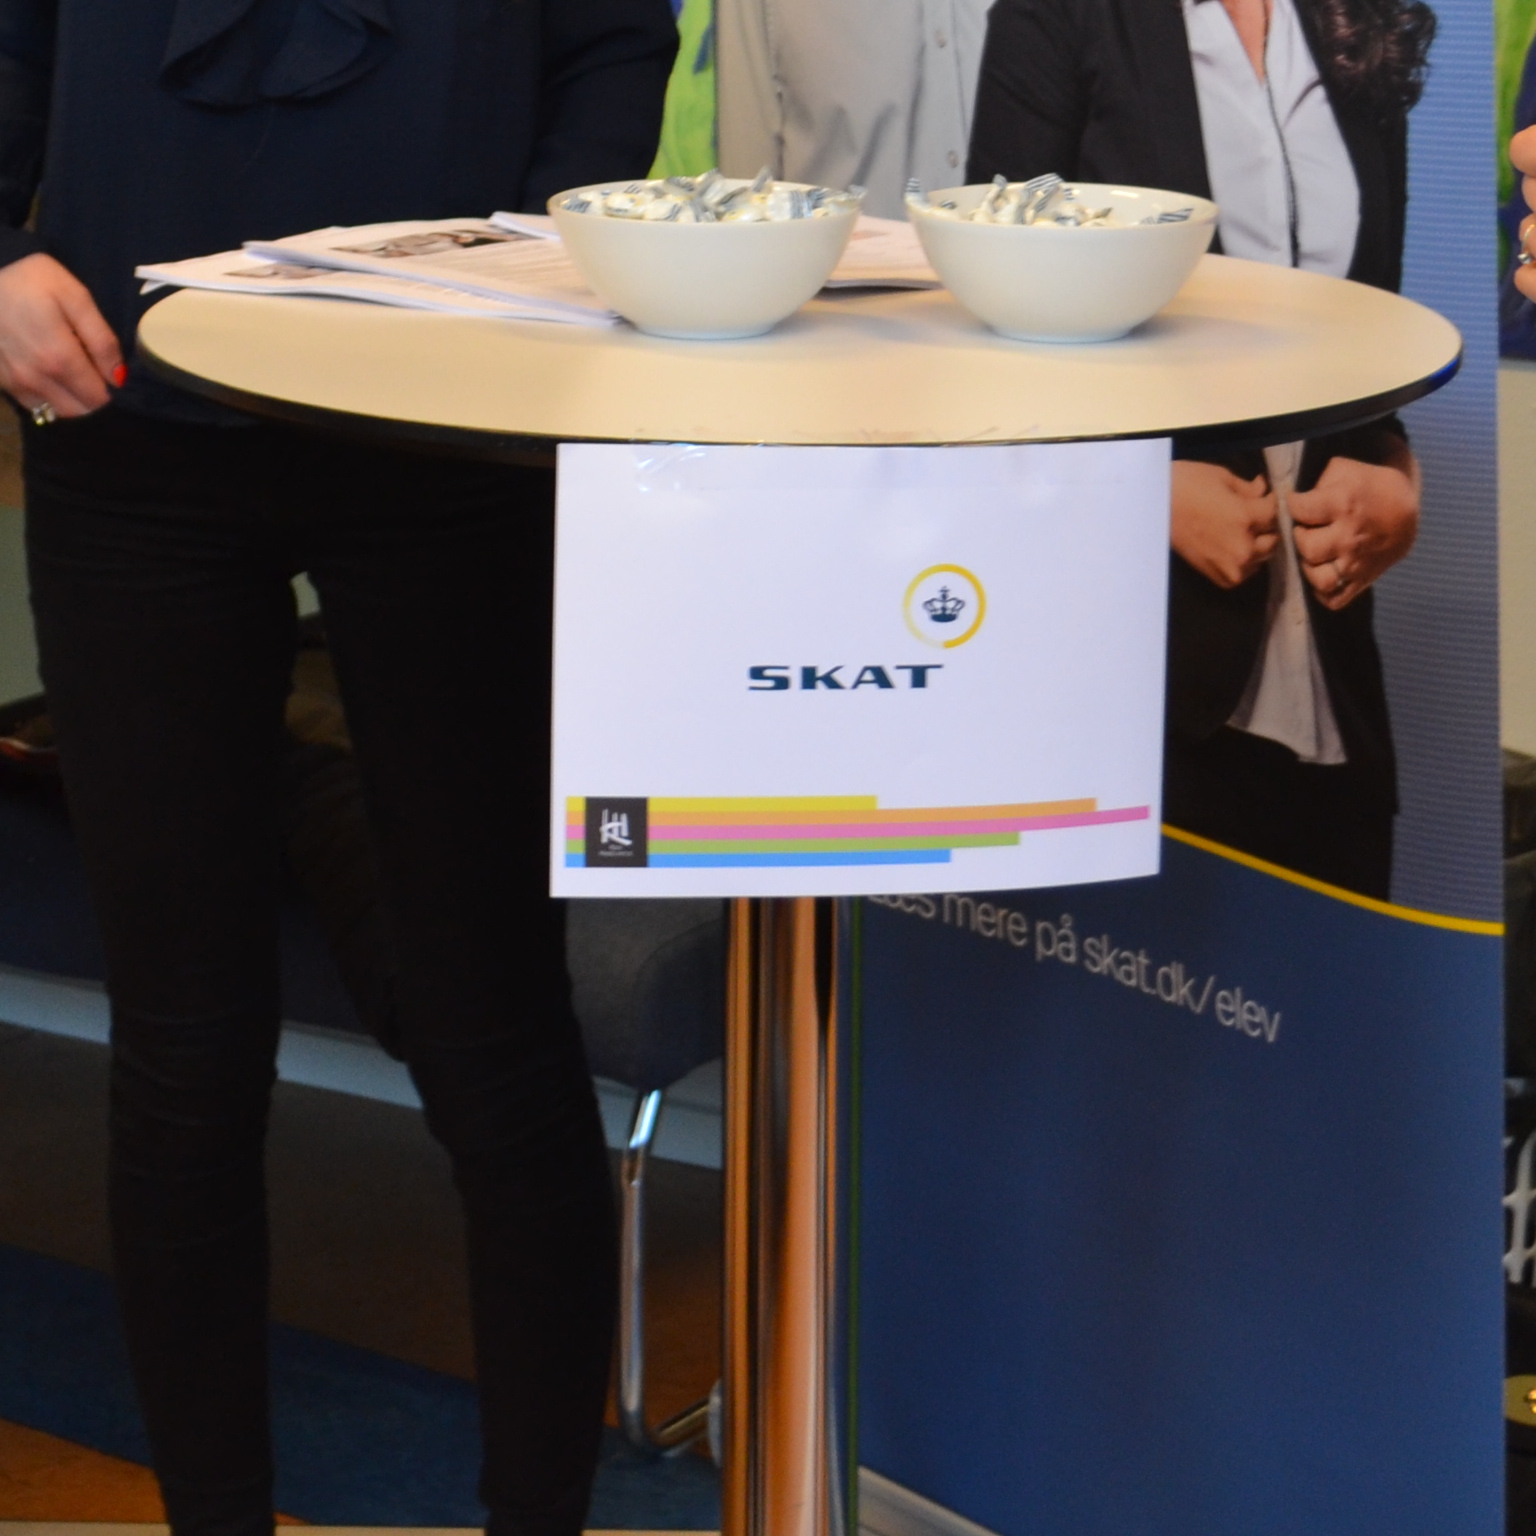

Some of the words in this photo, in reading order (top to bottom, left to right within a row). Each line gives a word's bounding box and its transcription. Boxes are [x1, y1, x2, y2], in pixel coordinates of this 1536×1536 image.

[747, 664, 944, 692] SKAT
[942, 893, 1028, 947] mere
[1035, 913, 1078, 963] på
